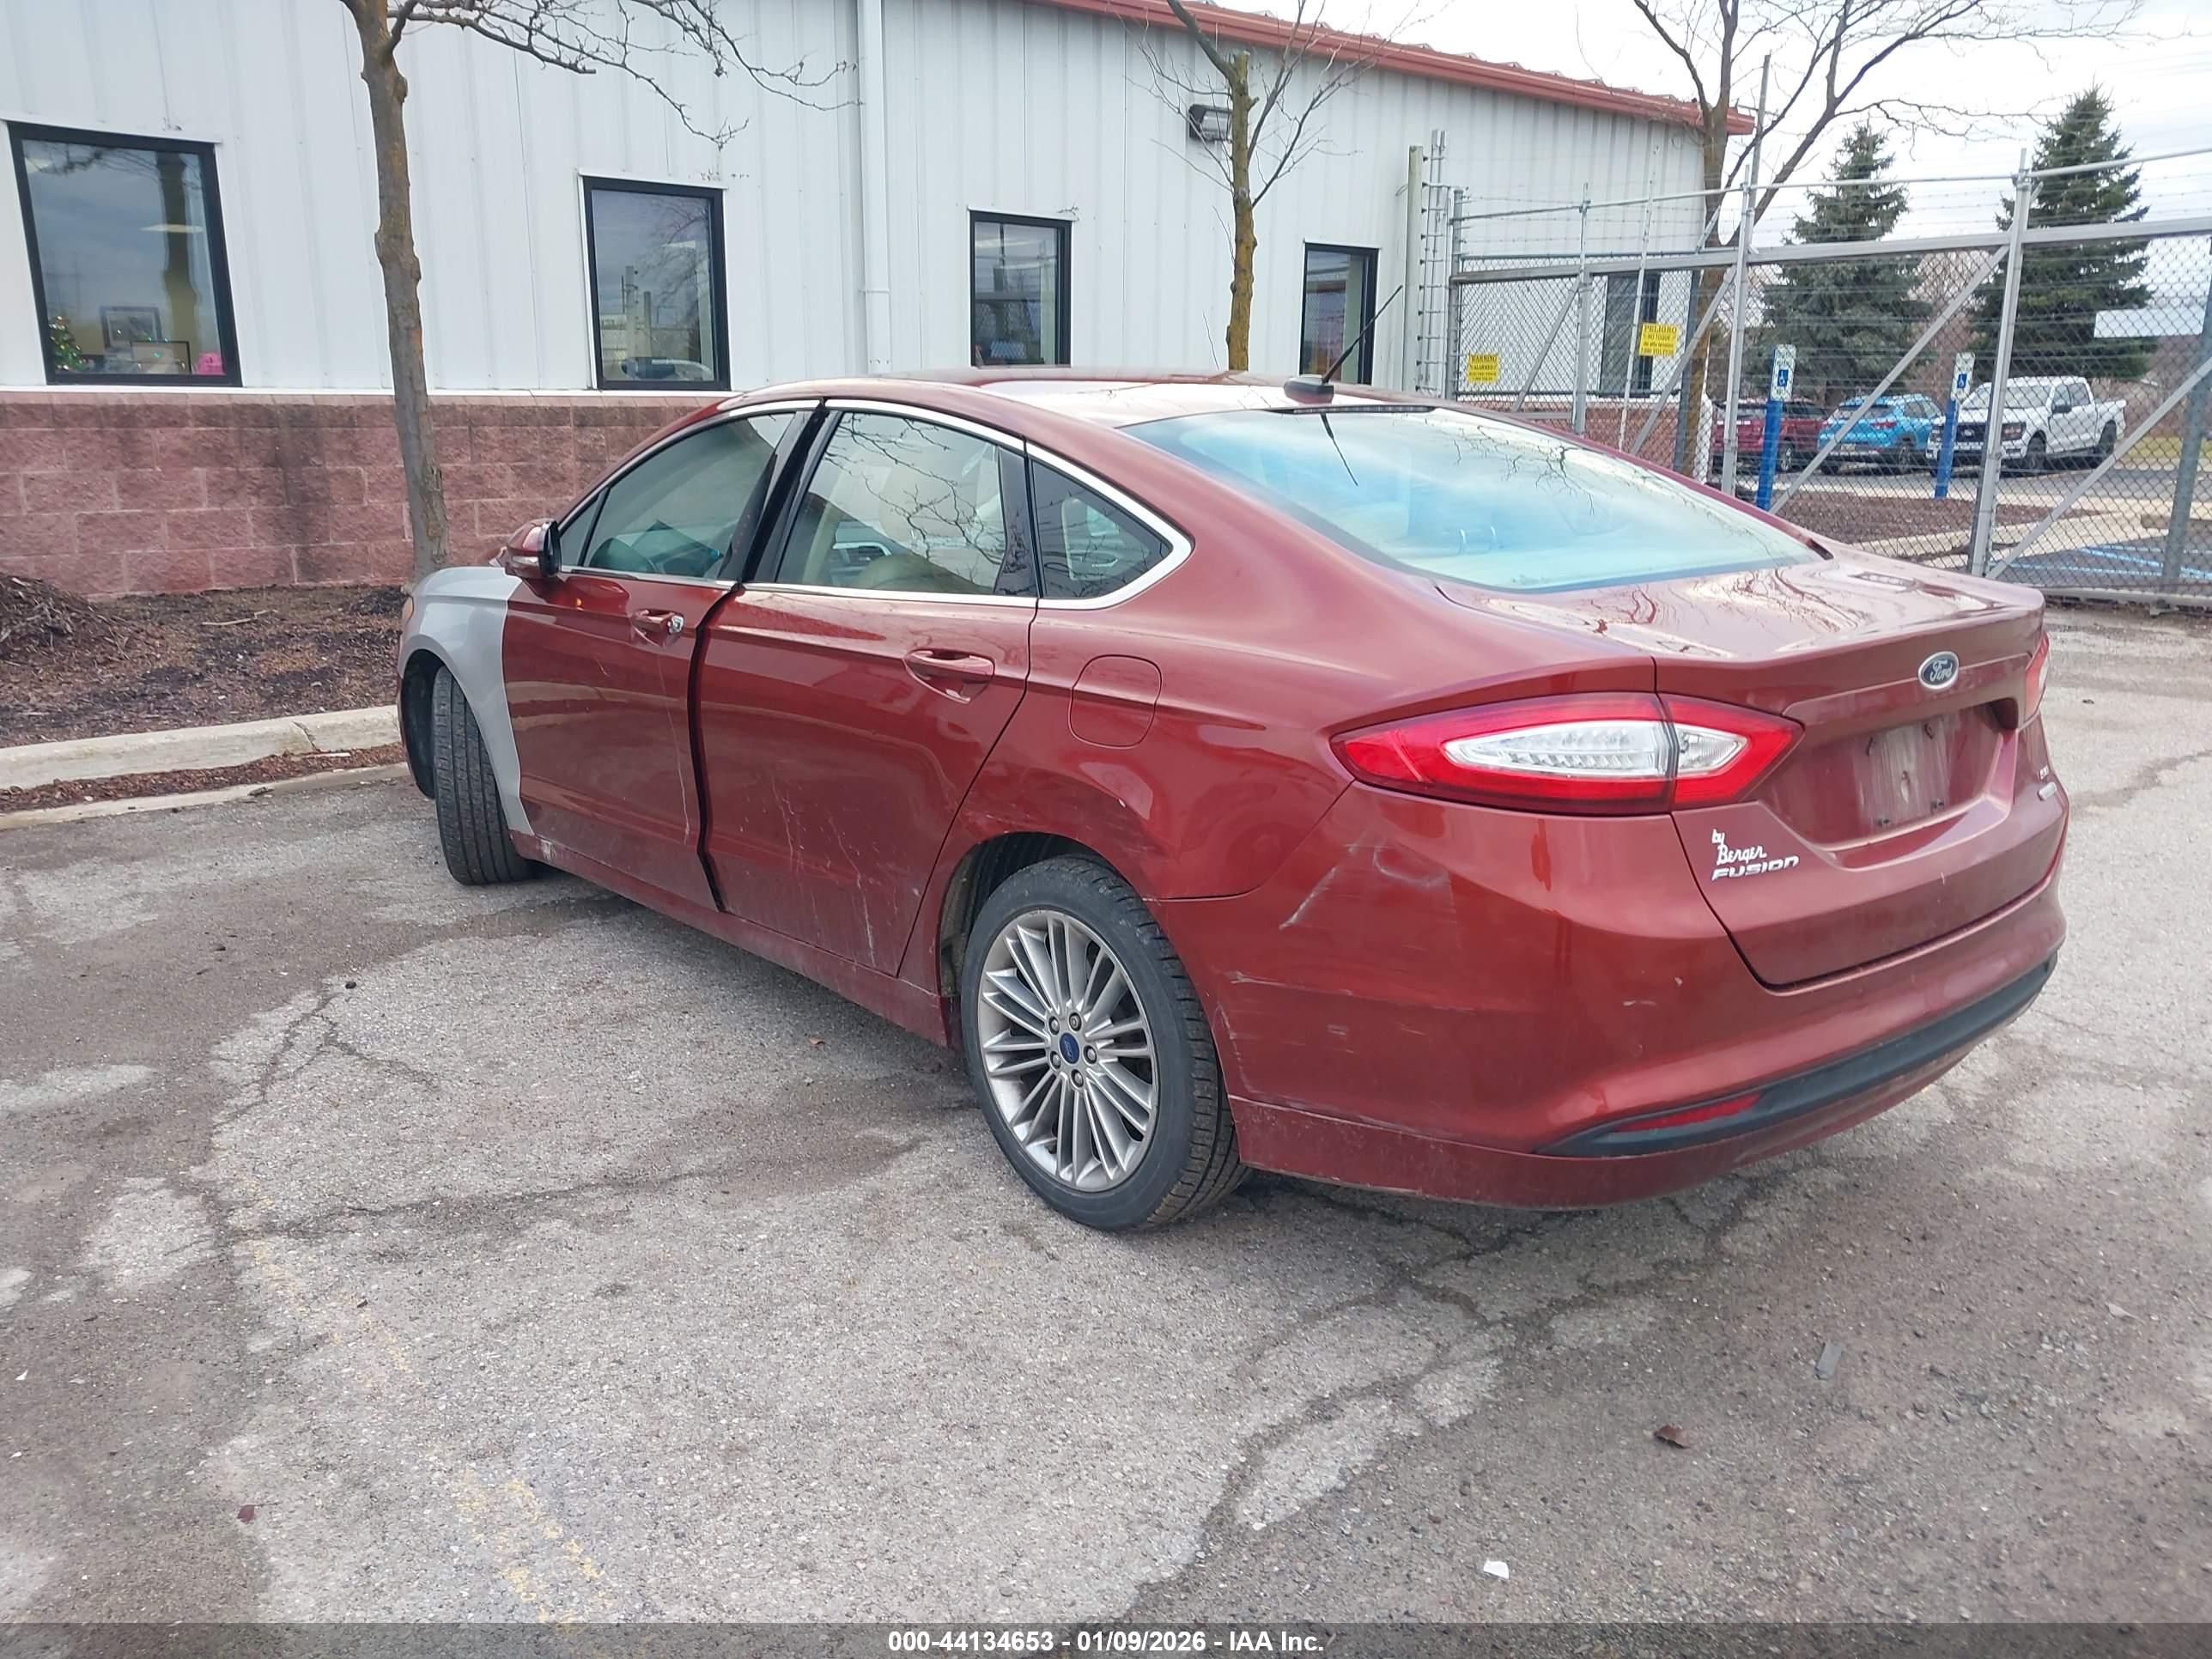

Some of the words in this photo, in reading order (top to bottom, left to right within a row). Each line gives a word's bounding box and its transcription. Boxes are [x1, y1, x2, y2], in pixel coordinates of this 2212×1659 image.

[1644, 325, 1677, 333] PELIGRO
[1470, 354, 1498, 362] WARNING
[1929, 659, 1953, 682] Ford
[1711, 829, 1725, 845] by
[1717, 845, 1767, 866] Berger
[1711, 855, 1799, 881] FUSION
